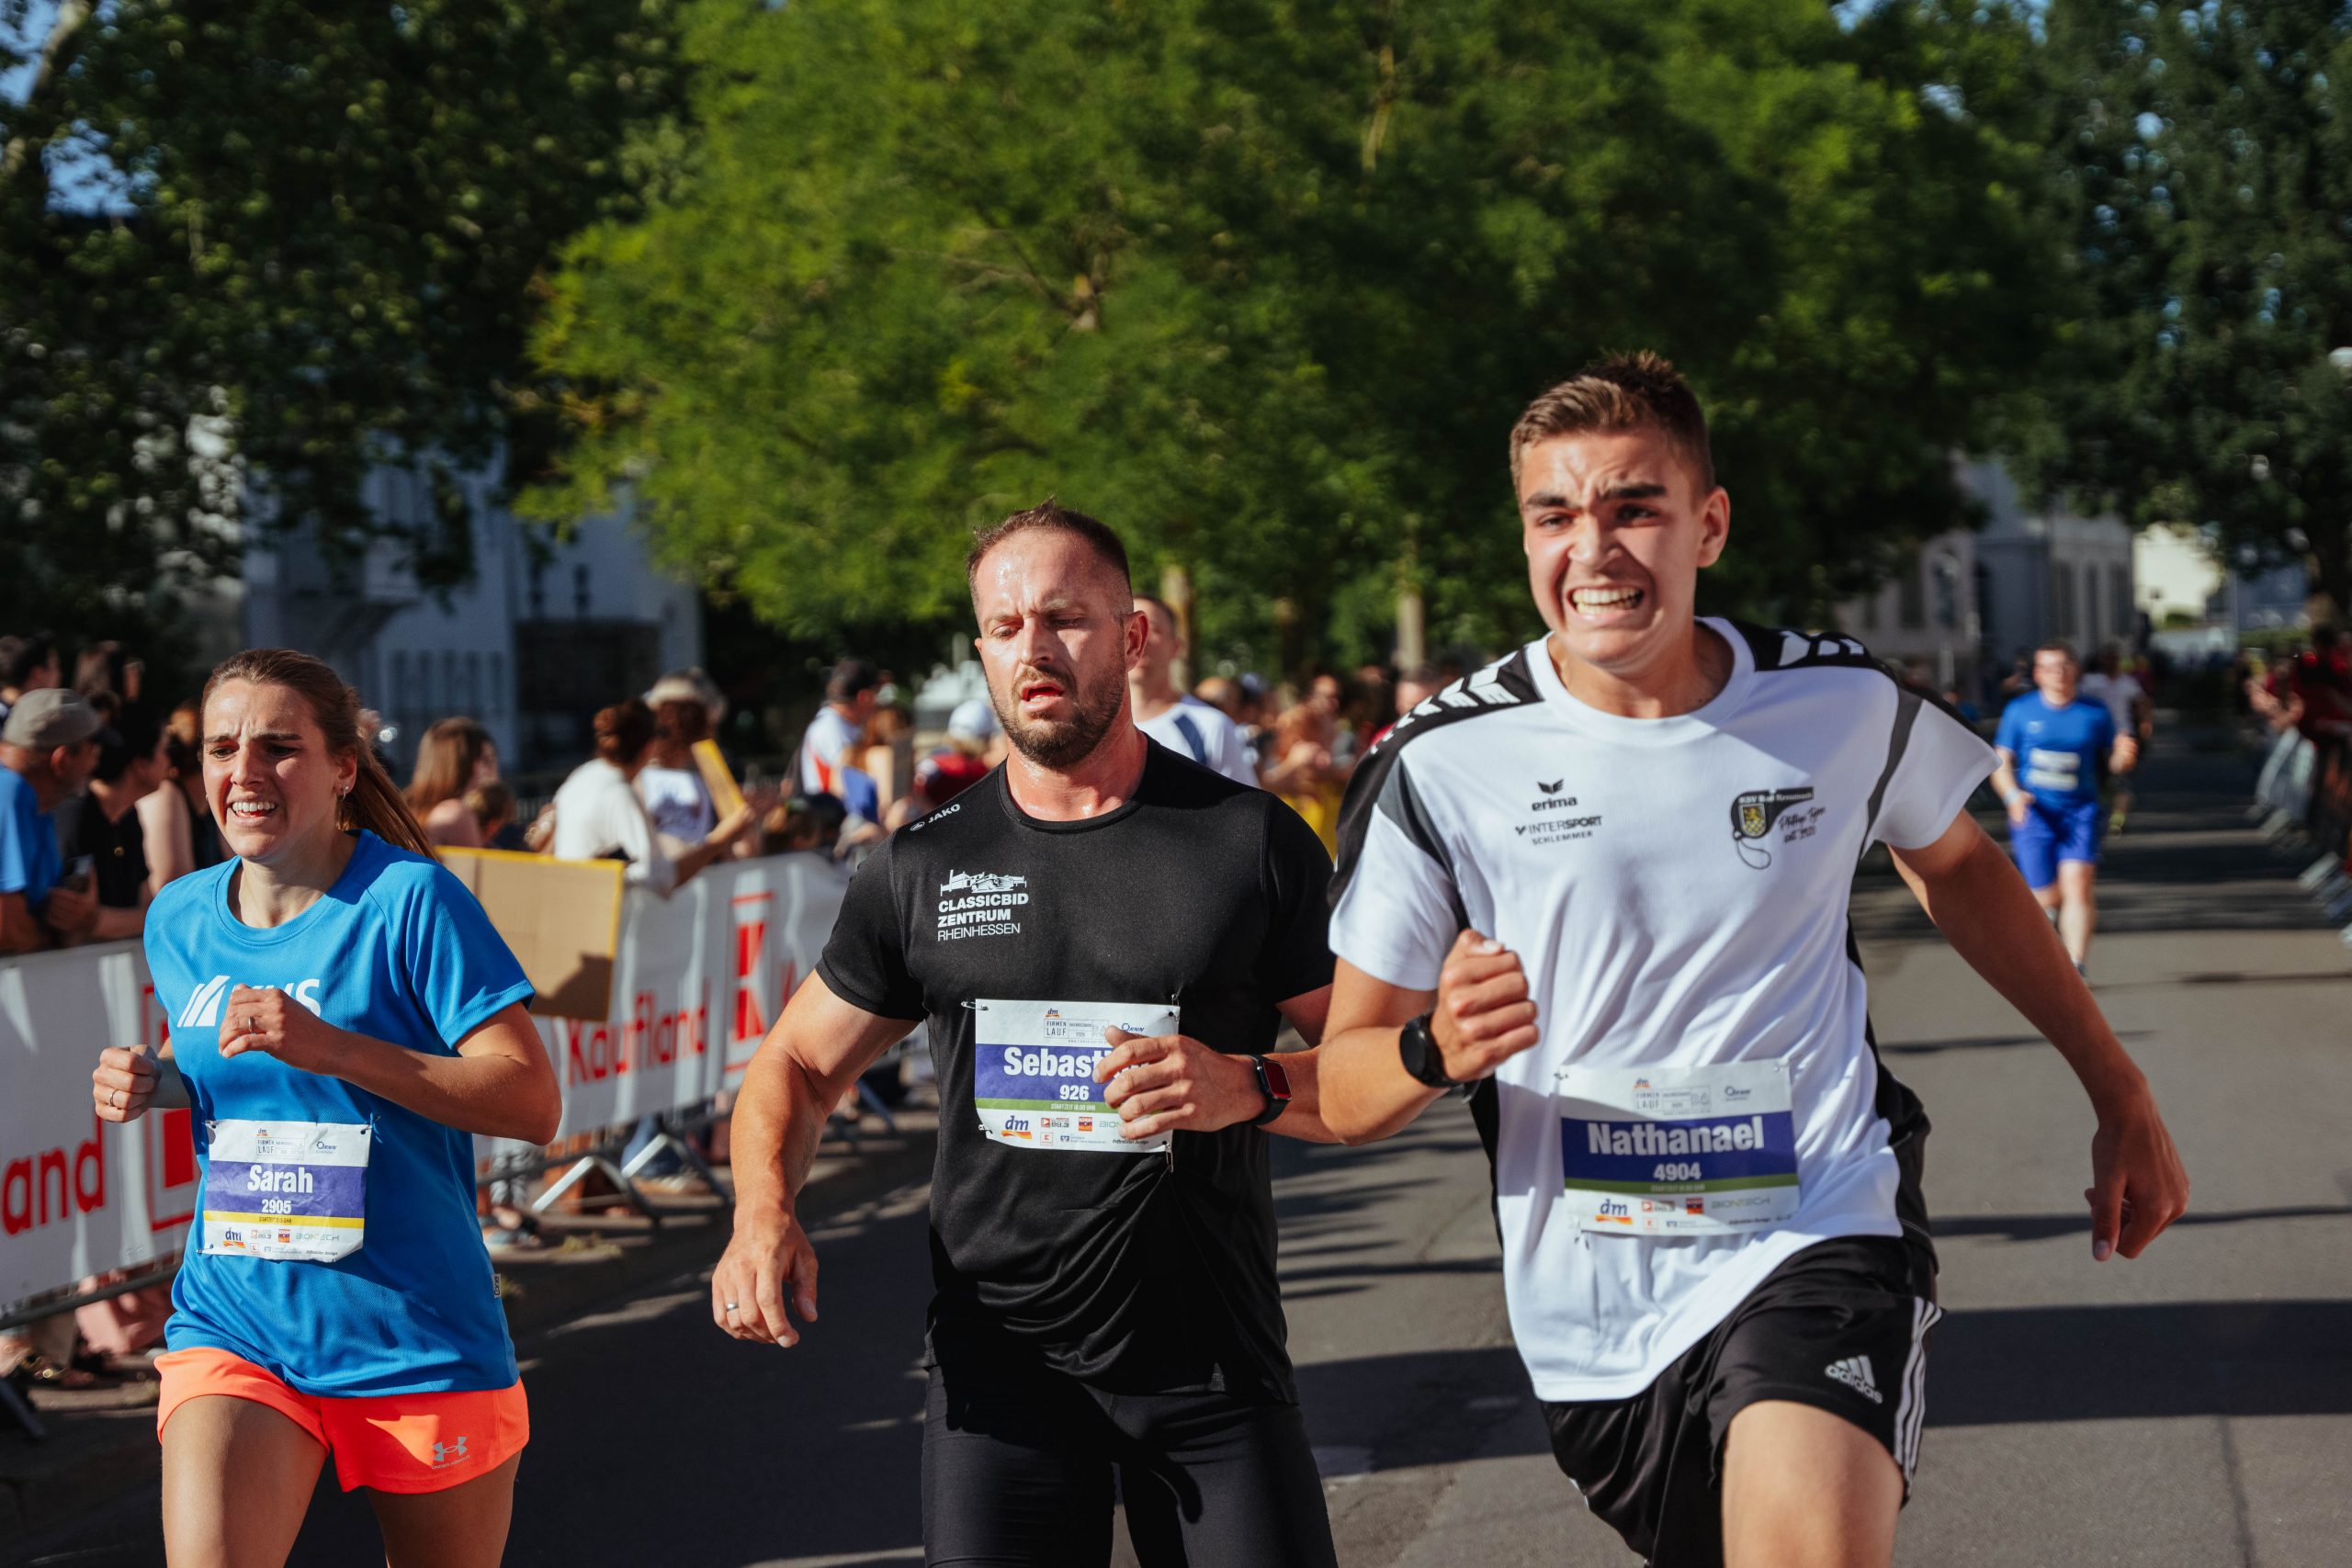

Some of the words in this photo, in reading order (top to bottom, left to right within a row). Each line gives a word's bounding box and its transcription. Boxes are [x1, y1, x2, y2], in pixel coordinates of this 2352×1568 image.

[1532, 796, 1577, 812] erima
[928, 803, 961, 824] JAKO
[1529, 816, 1602, 835] INTERSPORT
[1532, 830, 1593, 845] SCHLEMMER
[938, 893, 1029, 913] CLASSICBID
[937, 908, 1011, 929] ZENTRUM
[937, 922, 1021, 942] RHEINHESSEN
[567, 976, 711, 1087] Kaufland
[1046, 1028, 1066, 1036] LAUF
[1059, 1084, 1090, 1100] 926
[1005, 1115, 1029, 1131] dm
[1587, 1115, 1765, 1156] Nathanael
[257, 1145, 274, 1154] LAUF
[247, 1165, 313, 1193] Sarah
[1654, 1162, 1702, 1181] 4904
[261, 1199, 292, 1214] 2905
[1600, 1199, 1627, 1215] dm
[1712, 1197, 1771, 1209] BIONTECH
[225, 1227, 242, 1241] dm
[295, 1233, 340, 1241] BIONTECH
[1825, 1364, 1883, 1404] adidas
